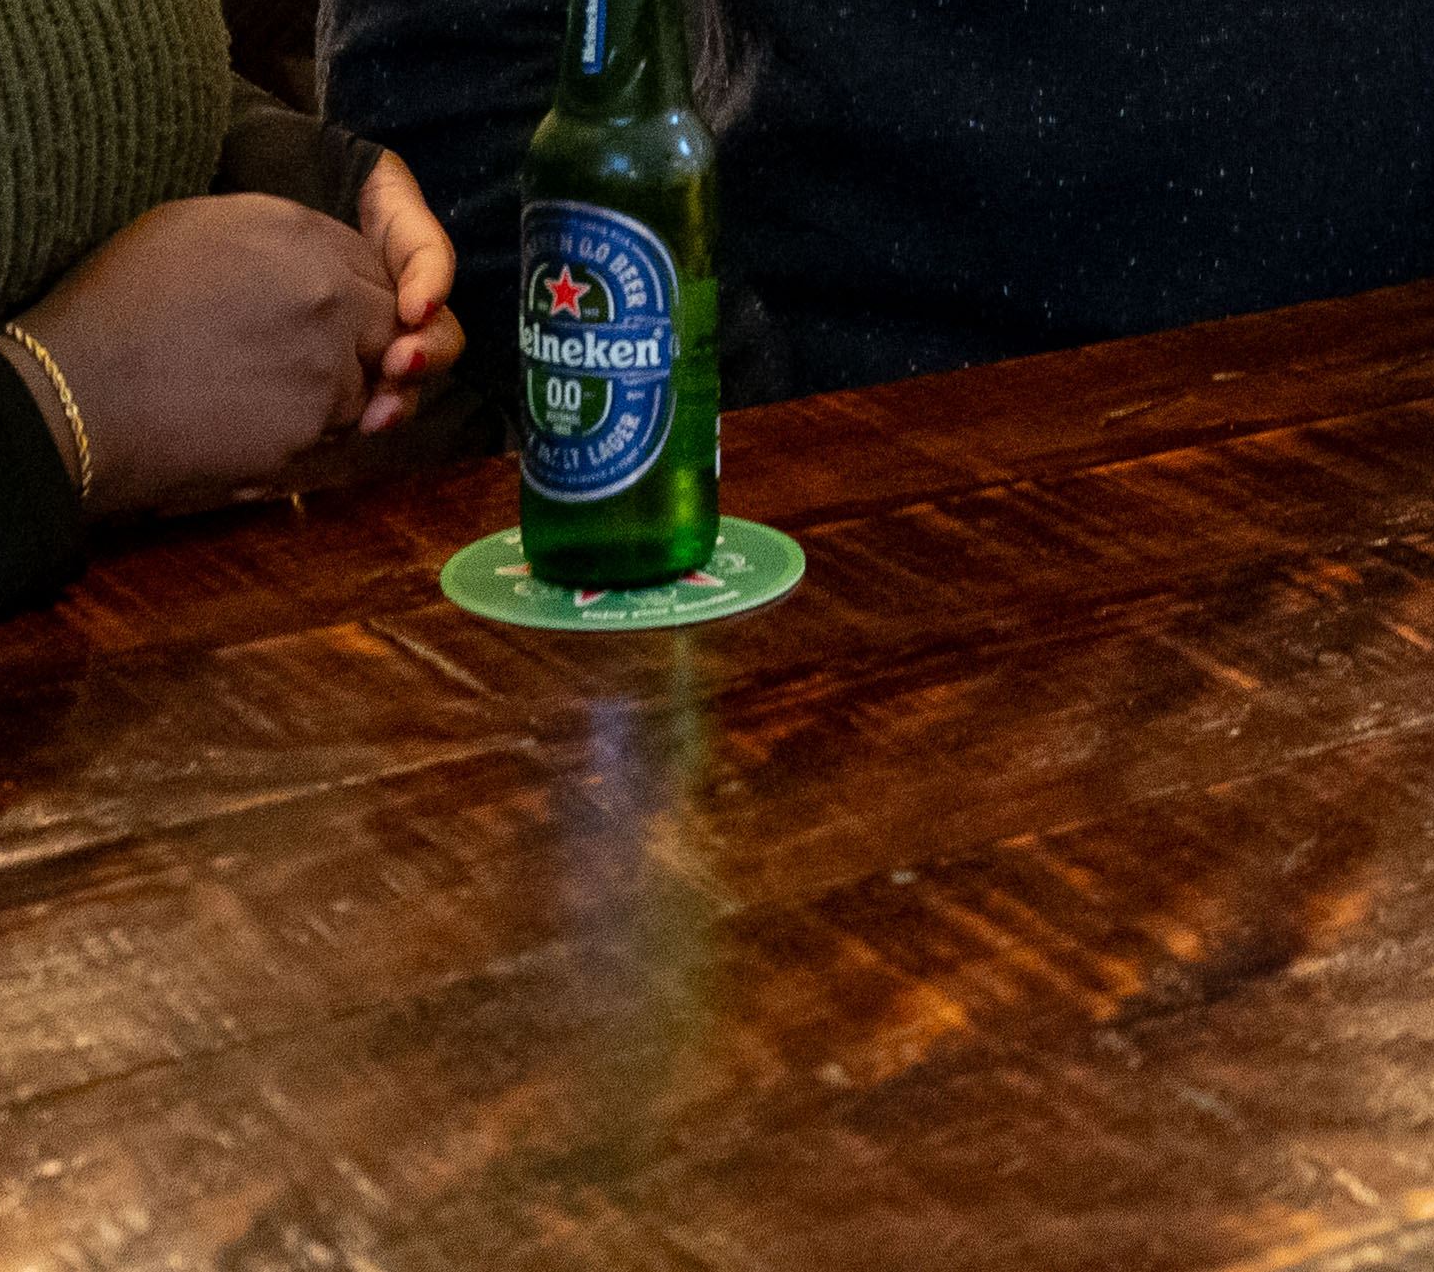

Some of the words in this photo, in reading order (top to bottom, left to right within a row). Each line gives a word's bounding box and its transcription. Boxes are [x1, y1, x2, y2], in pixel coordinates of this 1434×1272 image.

[608, 253, 647, 309] BEER
[521, 322, 661, 368] eineken
[587, 412, 641, 466] LAGER
